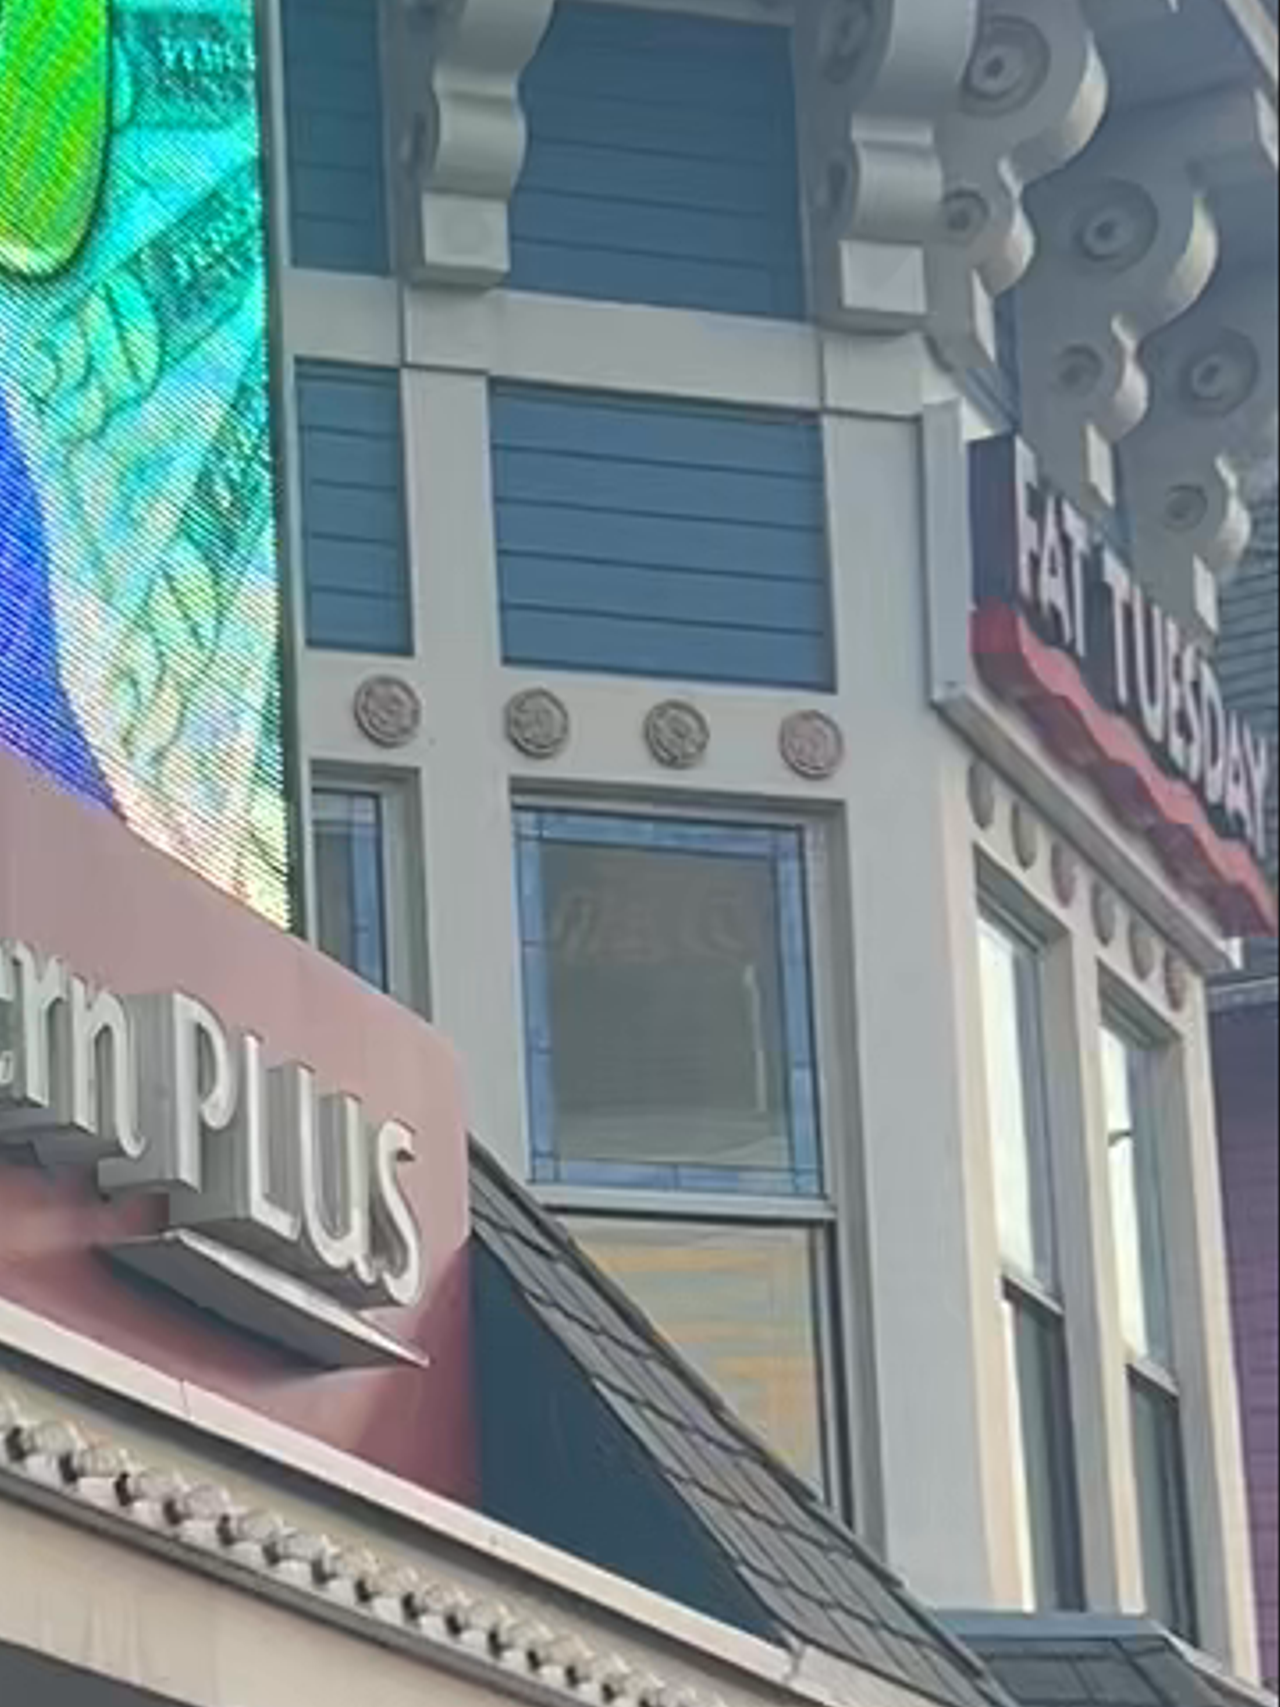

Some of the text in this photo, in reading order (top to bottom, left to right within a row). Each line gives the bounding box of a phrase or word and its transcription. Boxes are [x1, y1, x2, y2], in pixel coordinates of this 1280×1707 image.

[1014, 433, 1270, 859] FAT TUESDAY
[165, 988, 430, 1311] PLUS
